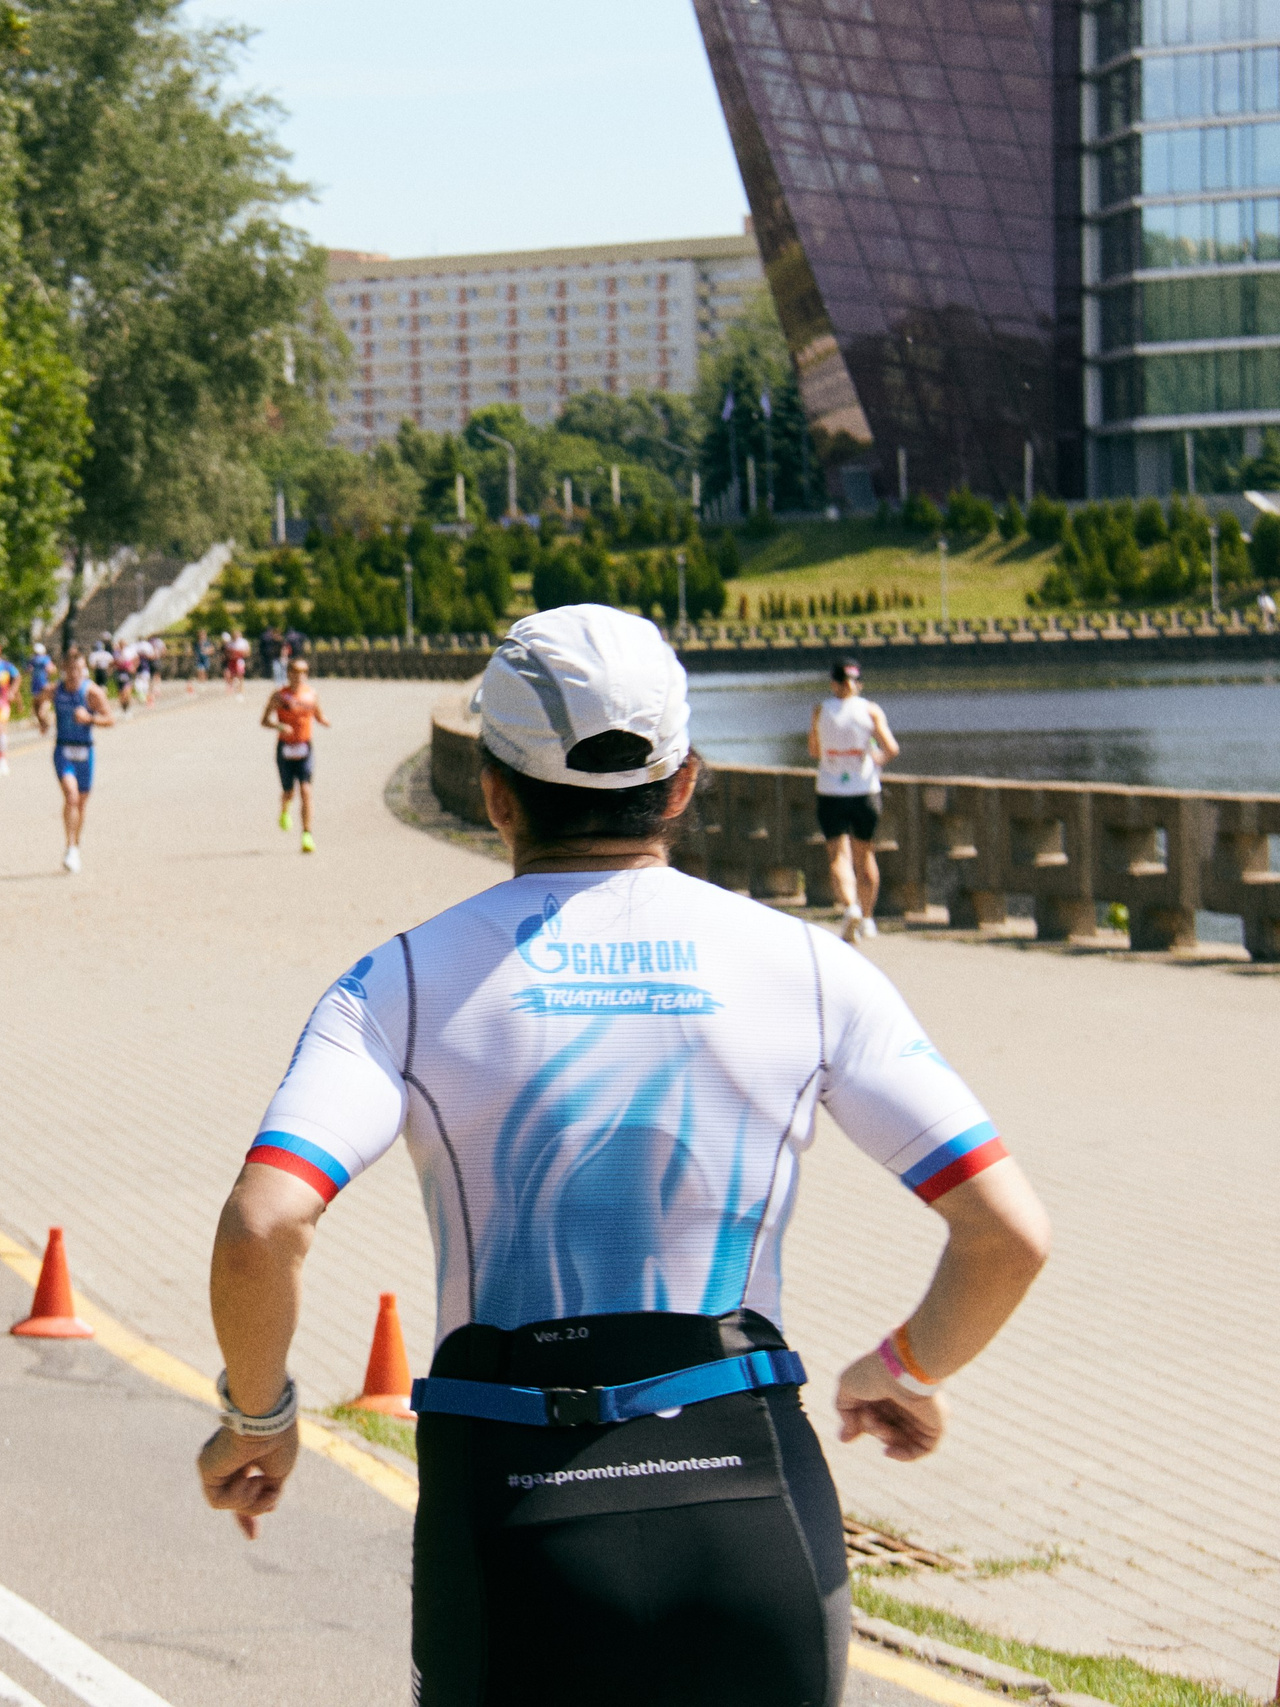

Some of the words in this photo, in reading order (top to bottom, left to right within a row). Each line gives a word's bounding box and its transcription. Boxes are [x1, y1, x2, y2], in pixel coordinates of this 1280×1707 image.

[572, 940, 698, 974] GAZPROM
[544, 988, 648, 1008] TRIATHLON
[651, 992, 704, 1011] TEAM
[533, 1332, 563, 1343] Ver.
[565, 1326, 589, 1340] 2.0
[508, 1455, 742, 1488] #gazpromtriathlonteam
